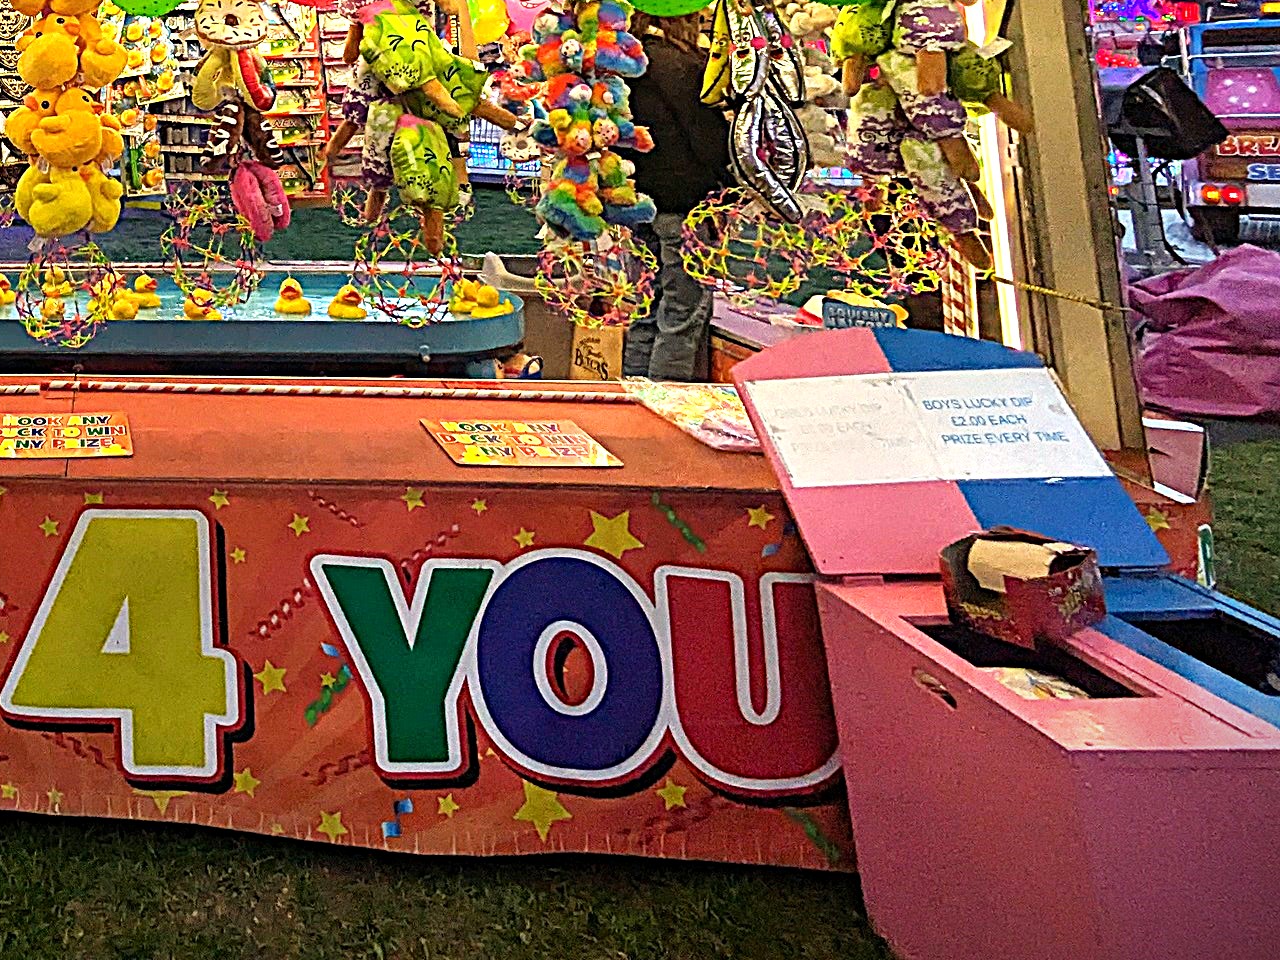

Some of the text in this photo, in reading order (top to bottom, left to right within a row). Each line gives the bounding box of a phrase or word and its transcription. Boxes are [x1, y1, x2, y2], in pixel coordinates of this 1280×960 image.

[922, 396, 1033, 411] BOYS LUCKY DIP
[951, 414, 1028, 427] £2.00 EACH
[54, 427, 82, 438] TO
[87, 426, 127, 436] WIN
[941, 430, 1070, 445] PRIZE EVERY TIME
[0, 508, 240, 777] 4
[310, 547, 843, 790] YOU
